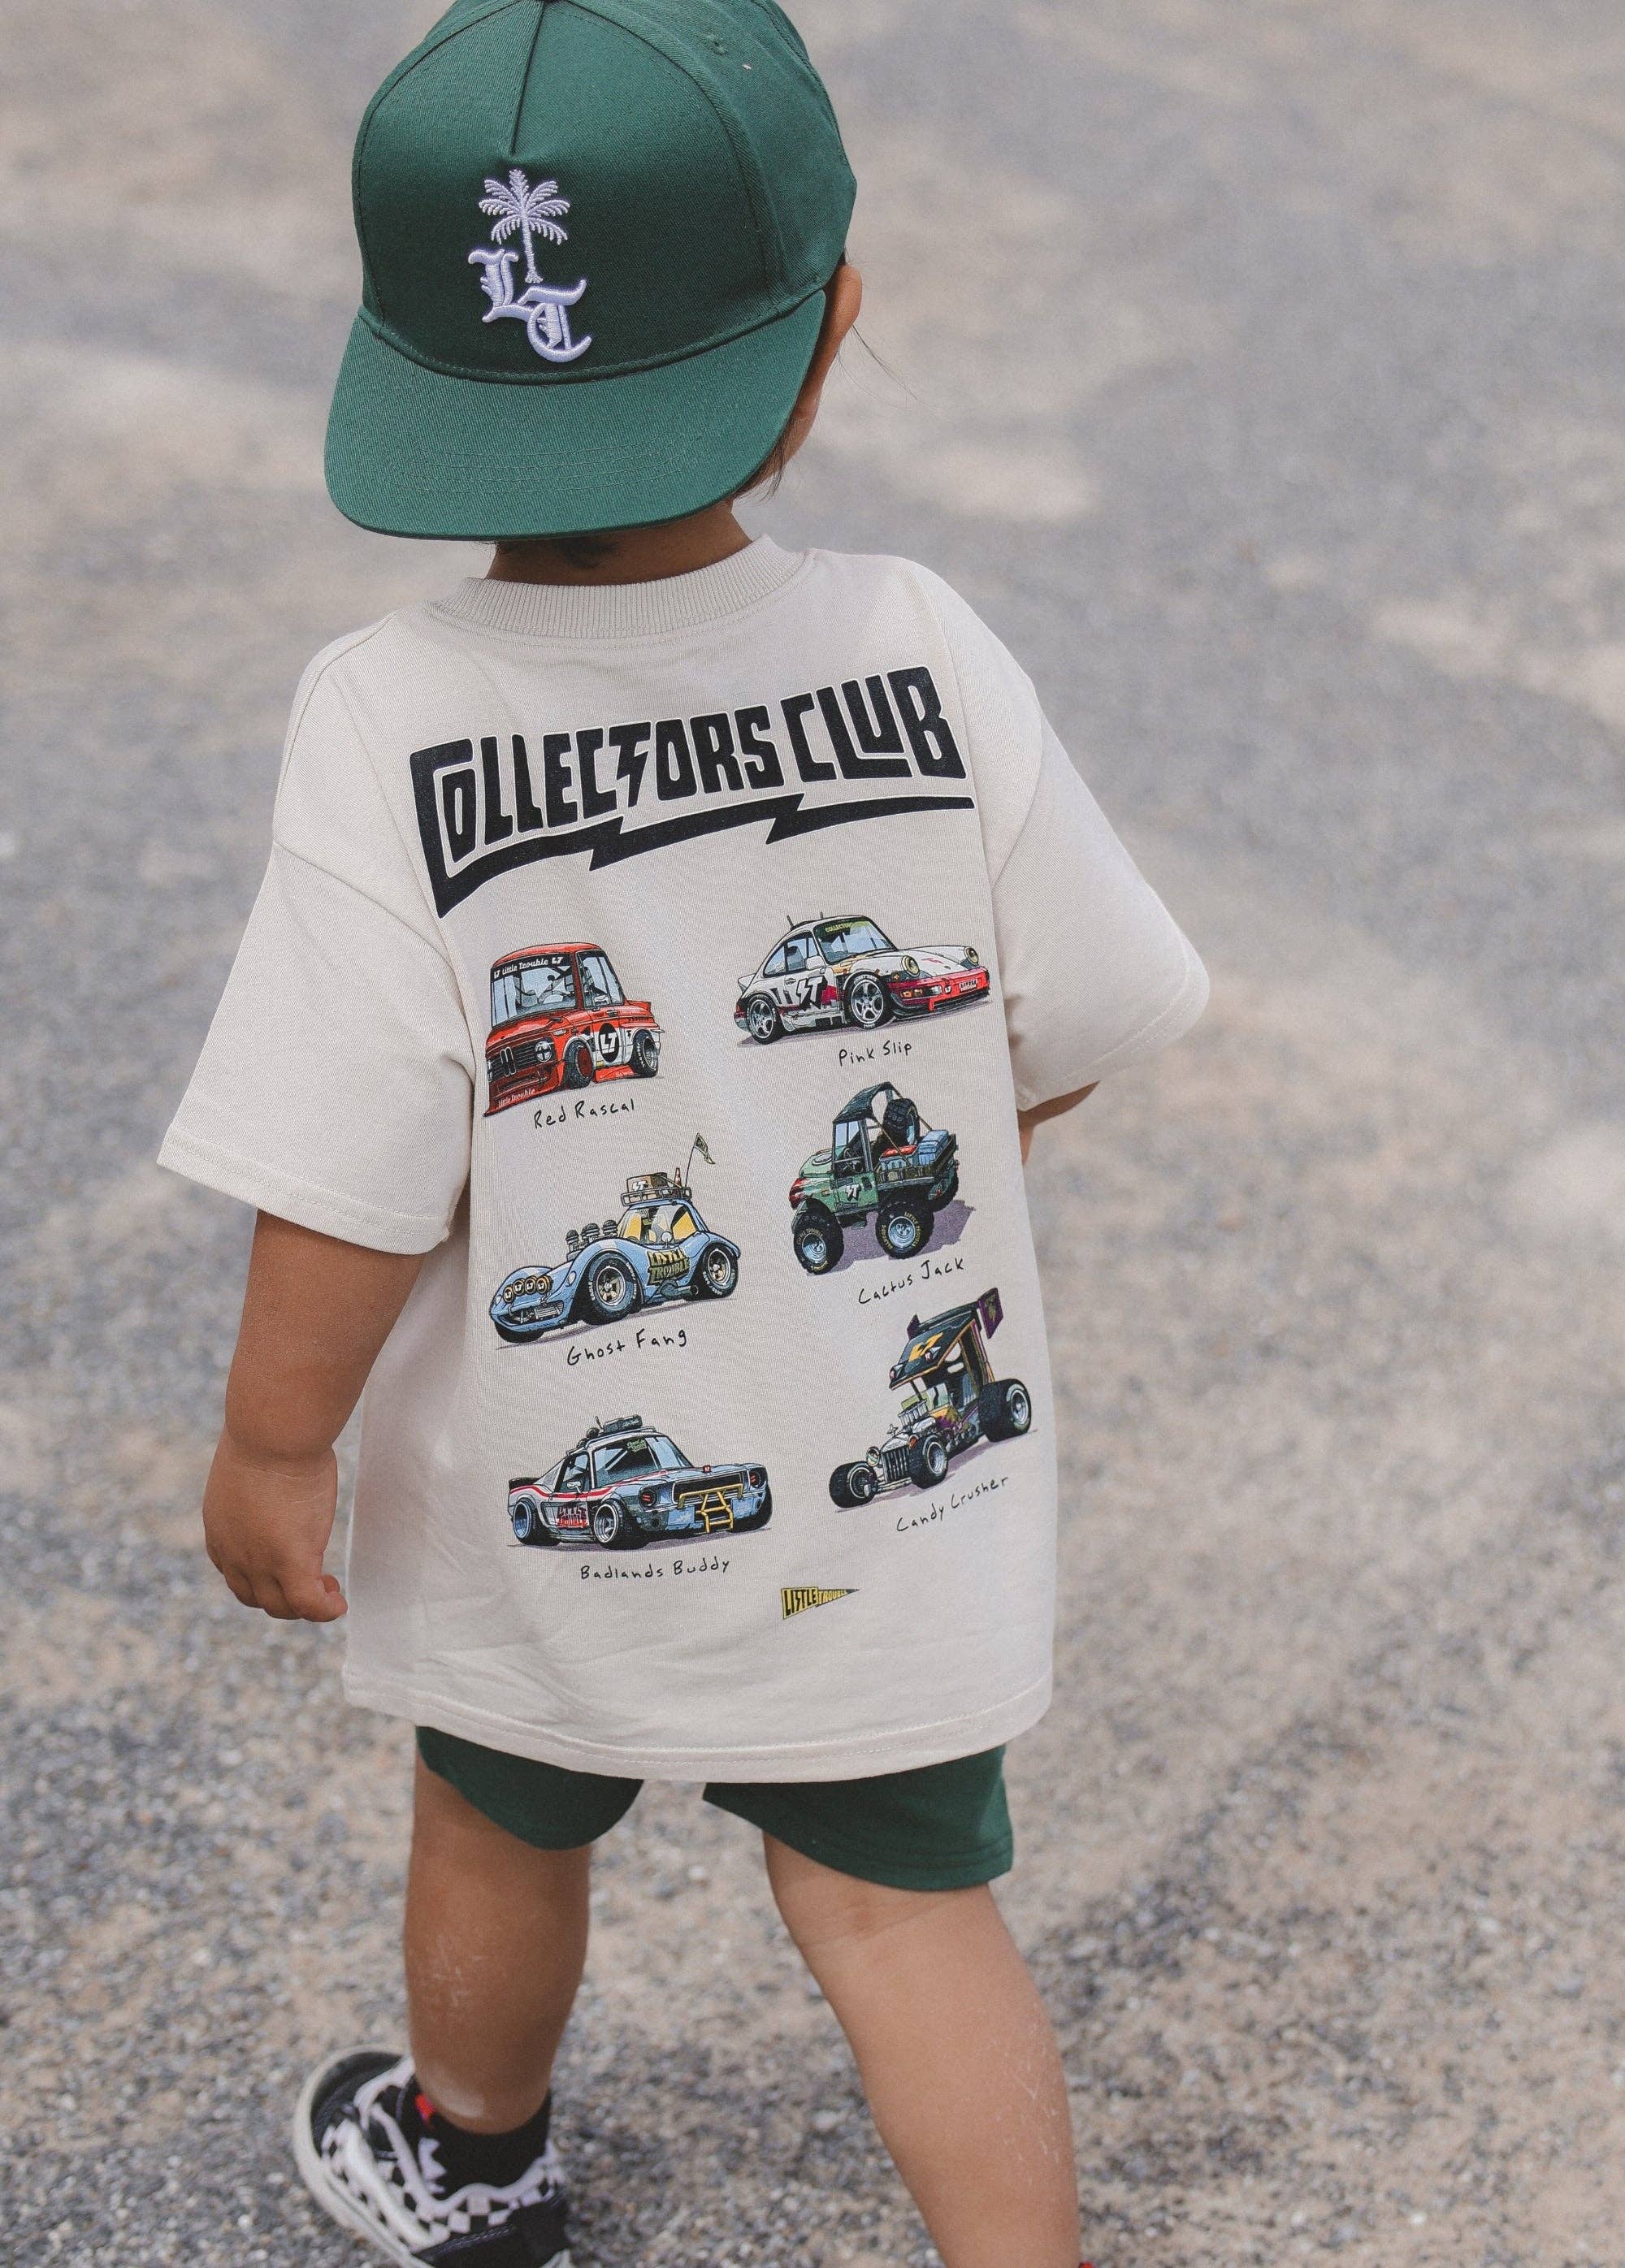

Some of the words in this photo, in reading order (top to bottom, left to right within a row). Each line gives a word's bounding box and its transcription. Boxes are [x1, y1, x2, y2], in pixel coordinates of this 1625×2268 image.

[410, 705, 785, 919] COLLECTORS
[780, 665, 967, 782] CLUB
[518, 959, 548, 969] Trouble
[600, 1032, 618, 1054] LT
[838, 1048, 874, 1067] Pink
[883, 1040, 912, 1057] Slip
[534, 1106, 566, 1129] Red
[574, 1098, 635, 1119] Rascal
[858, 1274, 913, 1305] Cactus
[921, 1258, 964, 1279] Jack
[567, 1337, 626, 1366] Ghost
[635, 1328, 687, 1348] Fang
[896, 1503, 944, 1532] Candy
[951, 1477, 1009, 1509] Crusher
[580, 1564, 664, 1580] Badlands
[673, 1556, 730, 1575] Buddy
